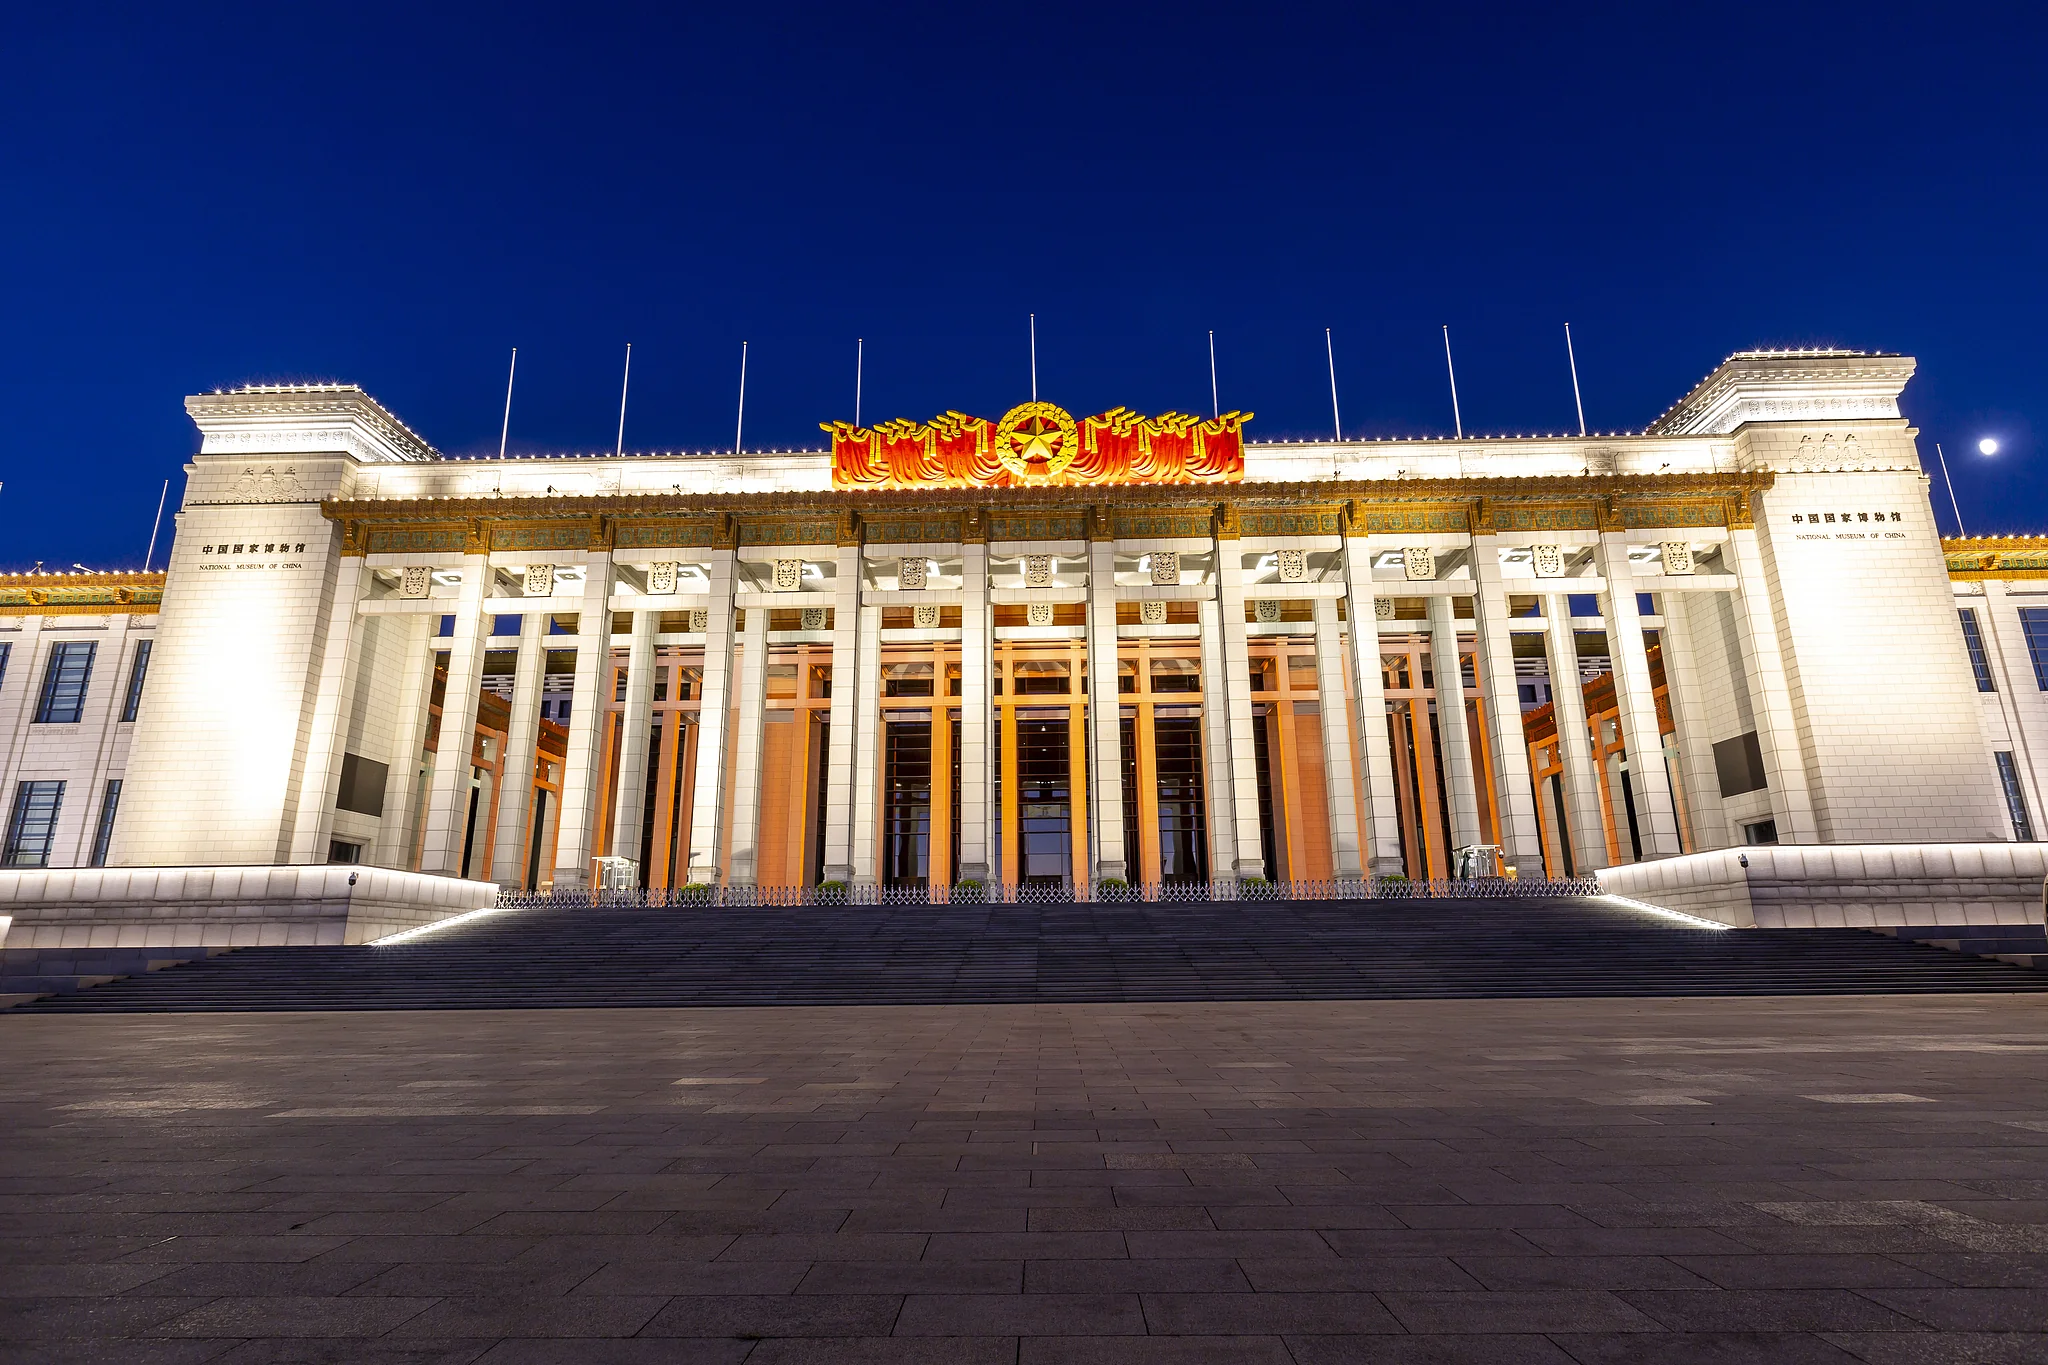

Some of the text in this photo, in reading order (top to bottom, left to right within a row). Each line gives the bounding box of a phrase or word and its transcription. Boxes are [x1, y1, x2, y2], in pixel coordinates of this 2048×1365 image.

[1791, 511, 1902, 524] 中国国家博物馆
[202, 542, 306, 555] 中国国家博物馆
